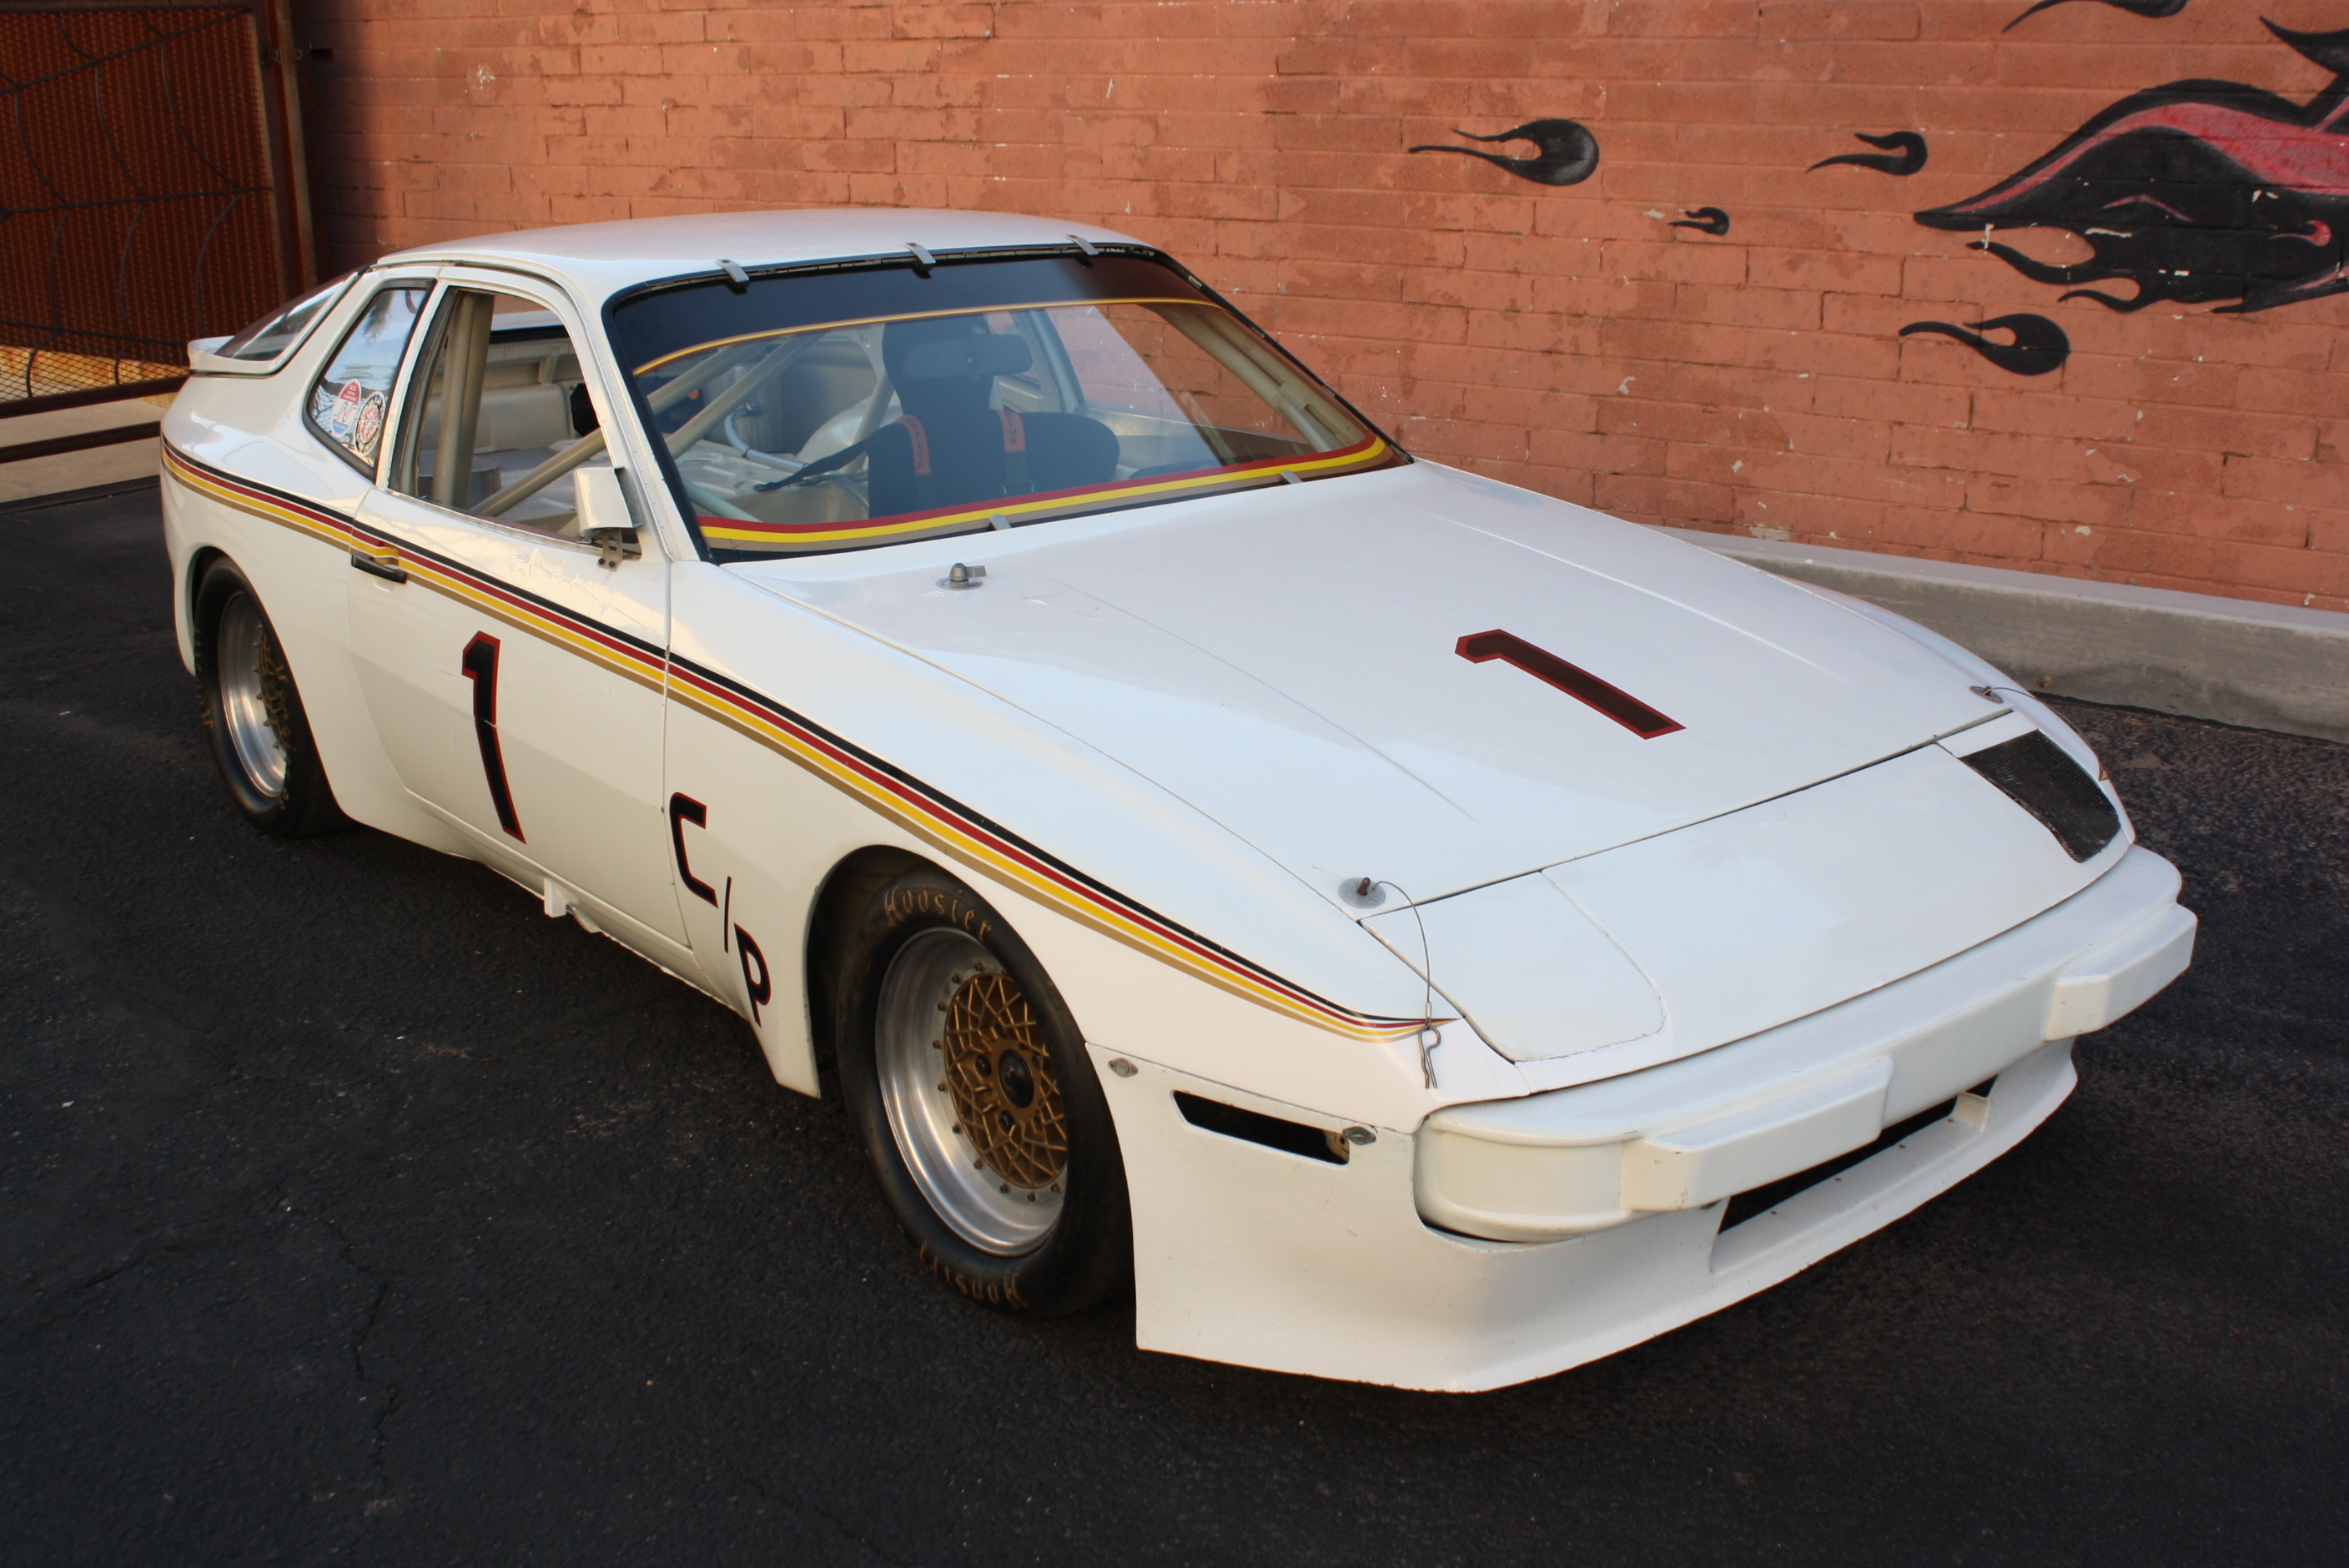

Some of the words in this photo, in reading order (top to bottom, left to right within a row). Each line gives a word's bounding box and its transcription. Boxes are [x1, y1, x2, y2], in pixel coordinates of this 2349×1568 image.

[462, 631, 526, 843] 1
[1455, 629, 1687, 740] 1
[883, 884, 994, 942] Hoosier
